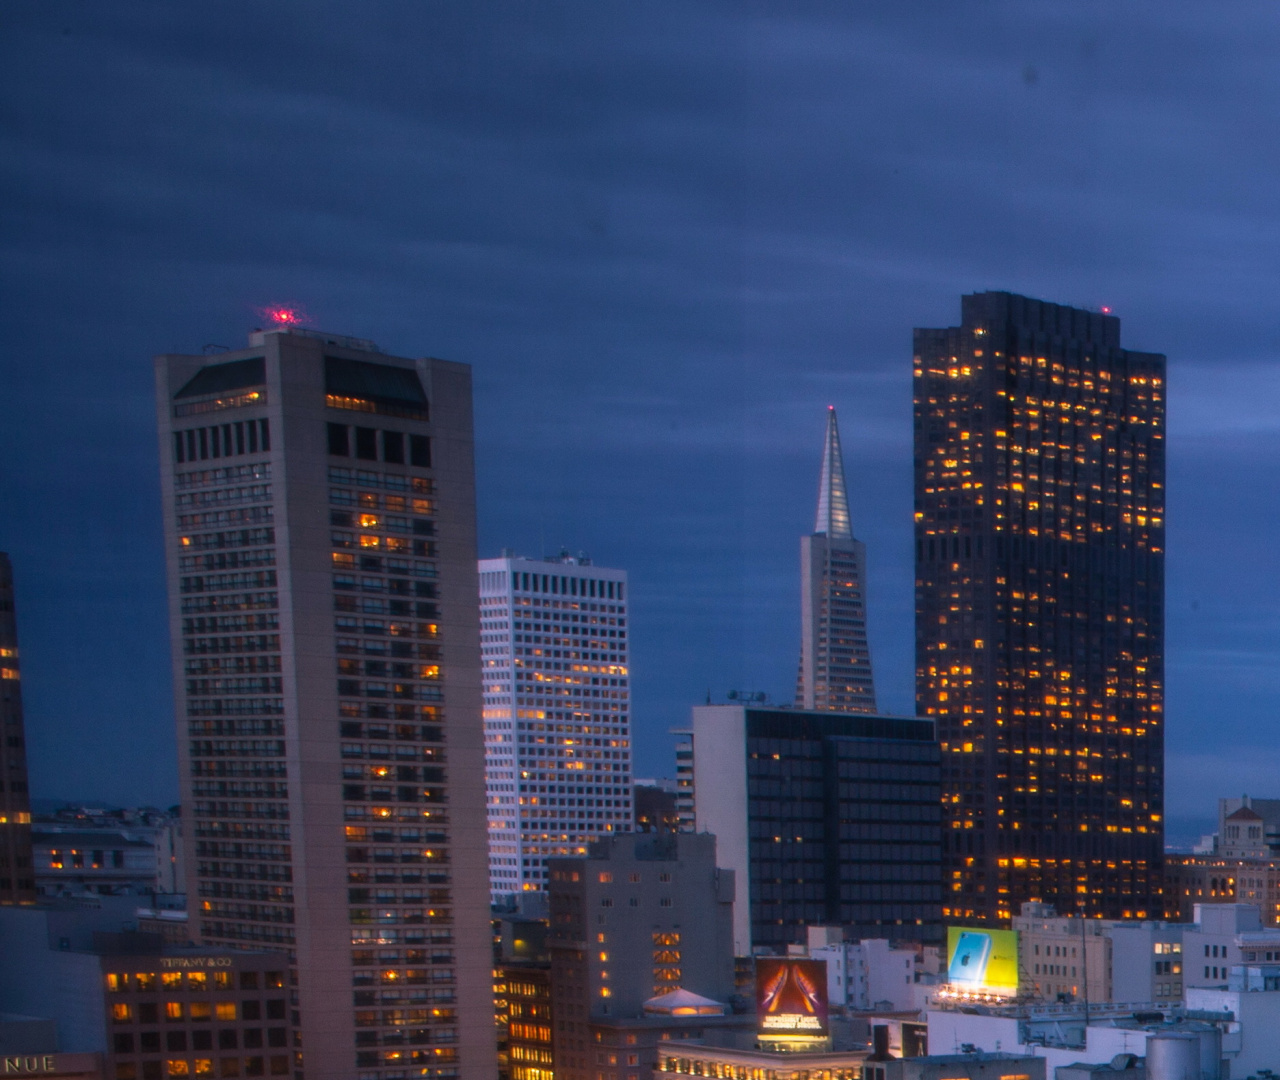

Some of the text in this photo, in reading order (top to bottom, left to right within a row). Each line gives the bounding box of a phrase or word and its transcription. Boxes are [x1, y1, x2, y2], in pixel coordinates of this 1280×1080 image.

[160, 957, 205, 968] TIFFANY
[207, 957, 215, 968] &
[5, 1056, 55, 1073] NUE
